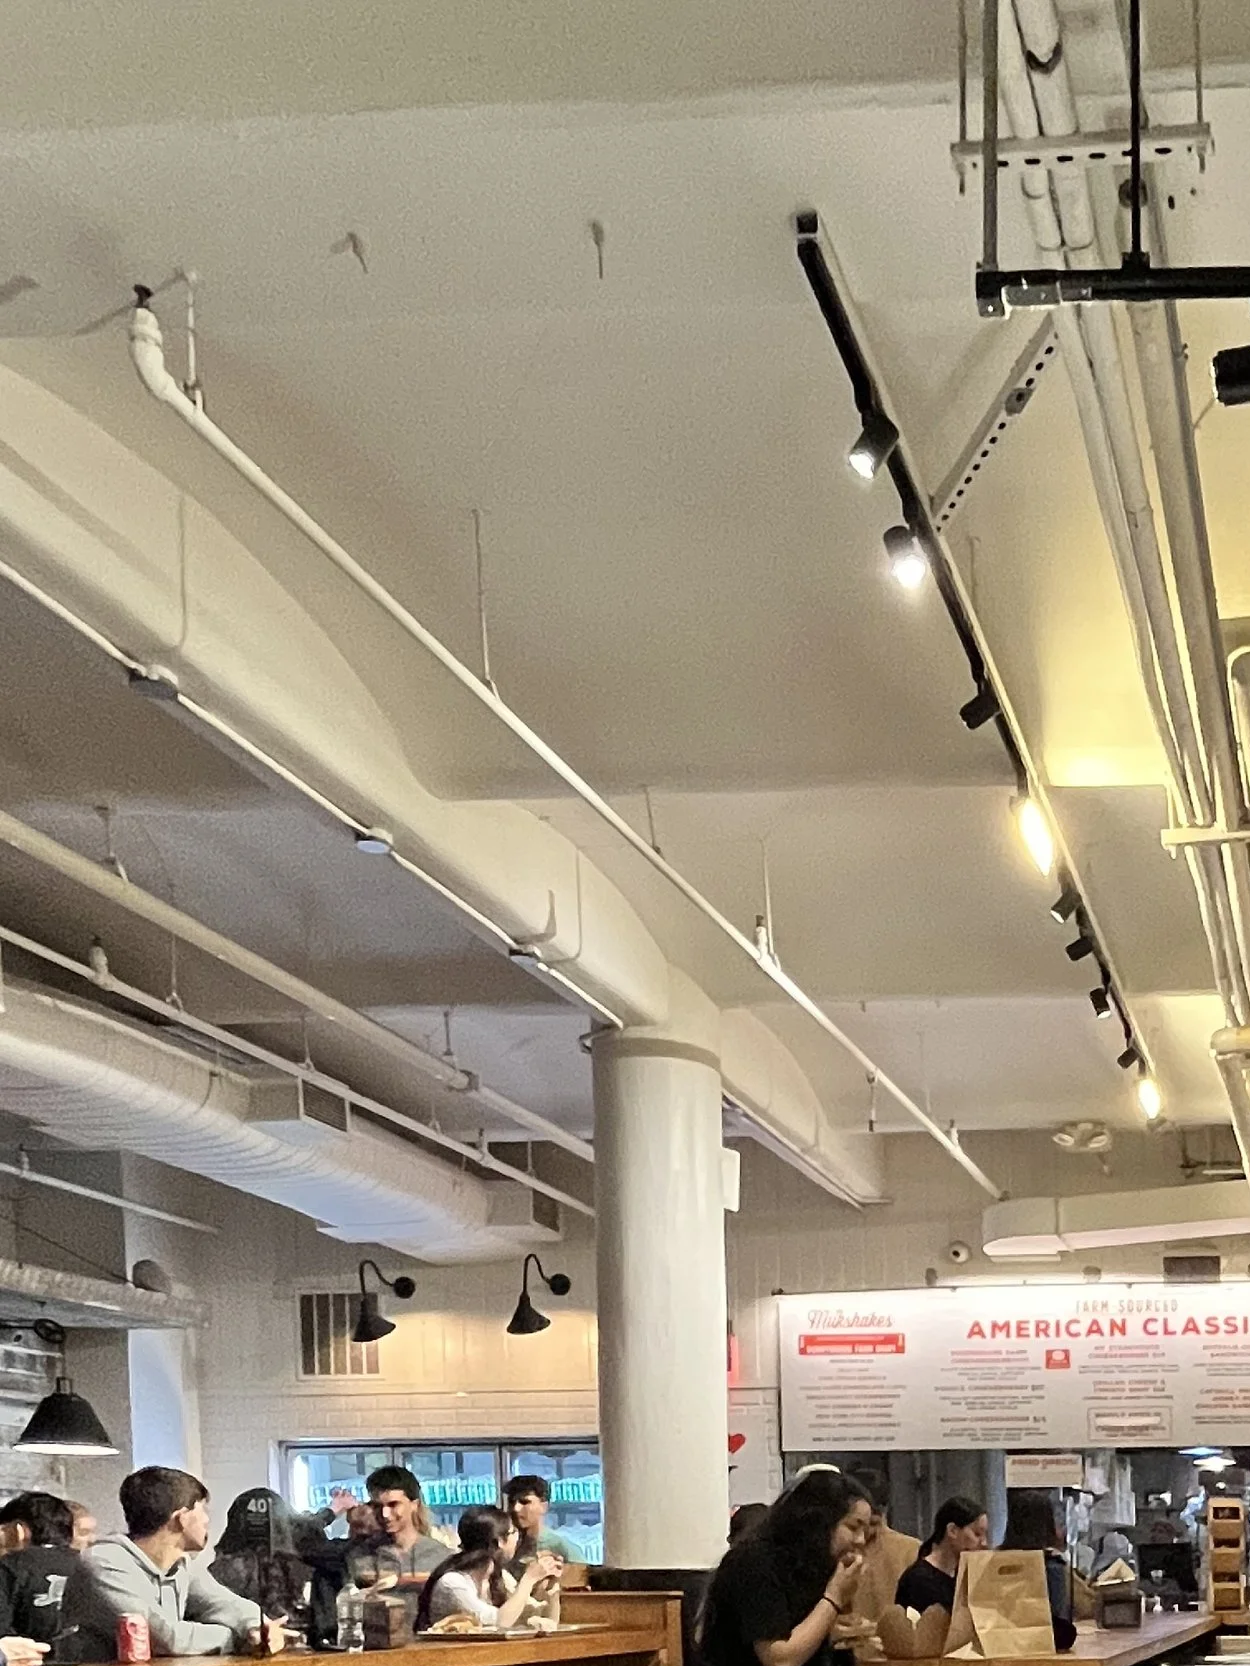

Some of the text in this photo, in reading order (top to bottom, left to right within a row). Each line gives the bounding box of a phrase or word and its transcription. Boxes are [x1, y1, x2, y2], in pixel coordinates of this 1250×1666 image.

[807, 1308, 893, 1329] Milkshakes
[967, 1318, 1127, 1339] AMERICAN
[247, 1498, 268, 1513] 40
